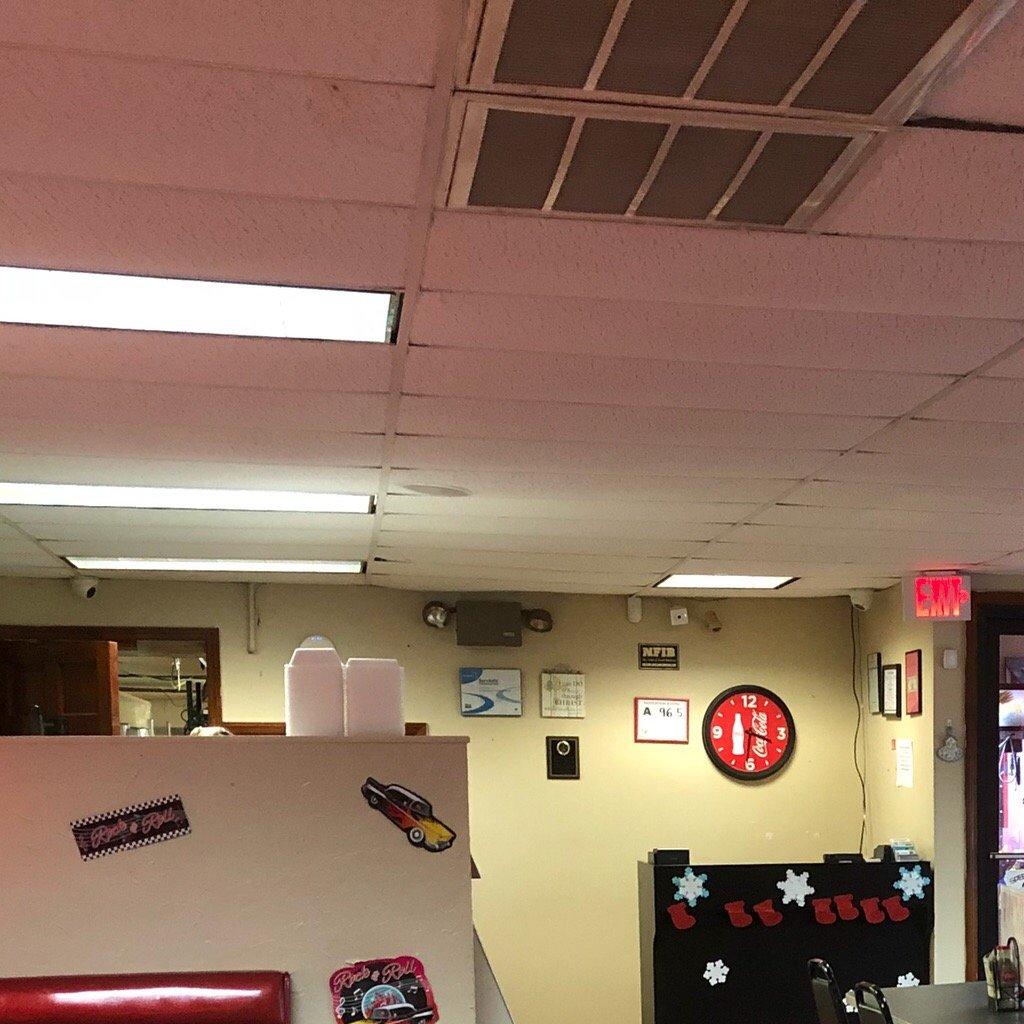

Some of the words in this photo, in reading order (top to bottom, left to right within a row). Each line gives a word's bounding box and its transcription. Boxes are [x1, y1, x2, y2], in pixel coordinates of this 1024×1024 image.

[642, 647, 676, 658] NFIB
[741, 695, 757, 708] 12
[643, 706, 651, 716] A
[712, 725, 723, 739] 9
[752, 709, 768, 758] CocaCola
[777, 726, 787, 740] 3
[745, 757, 756, 771] 6
